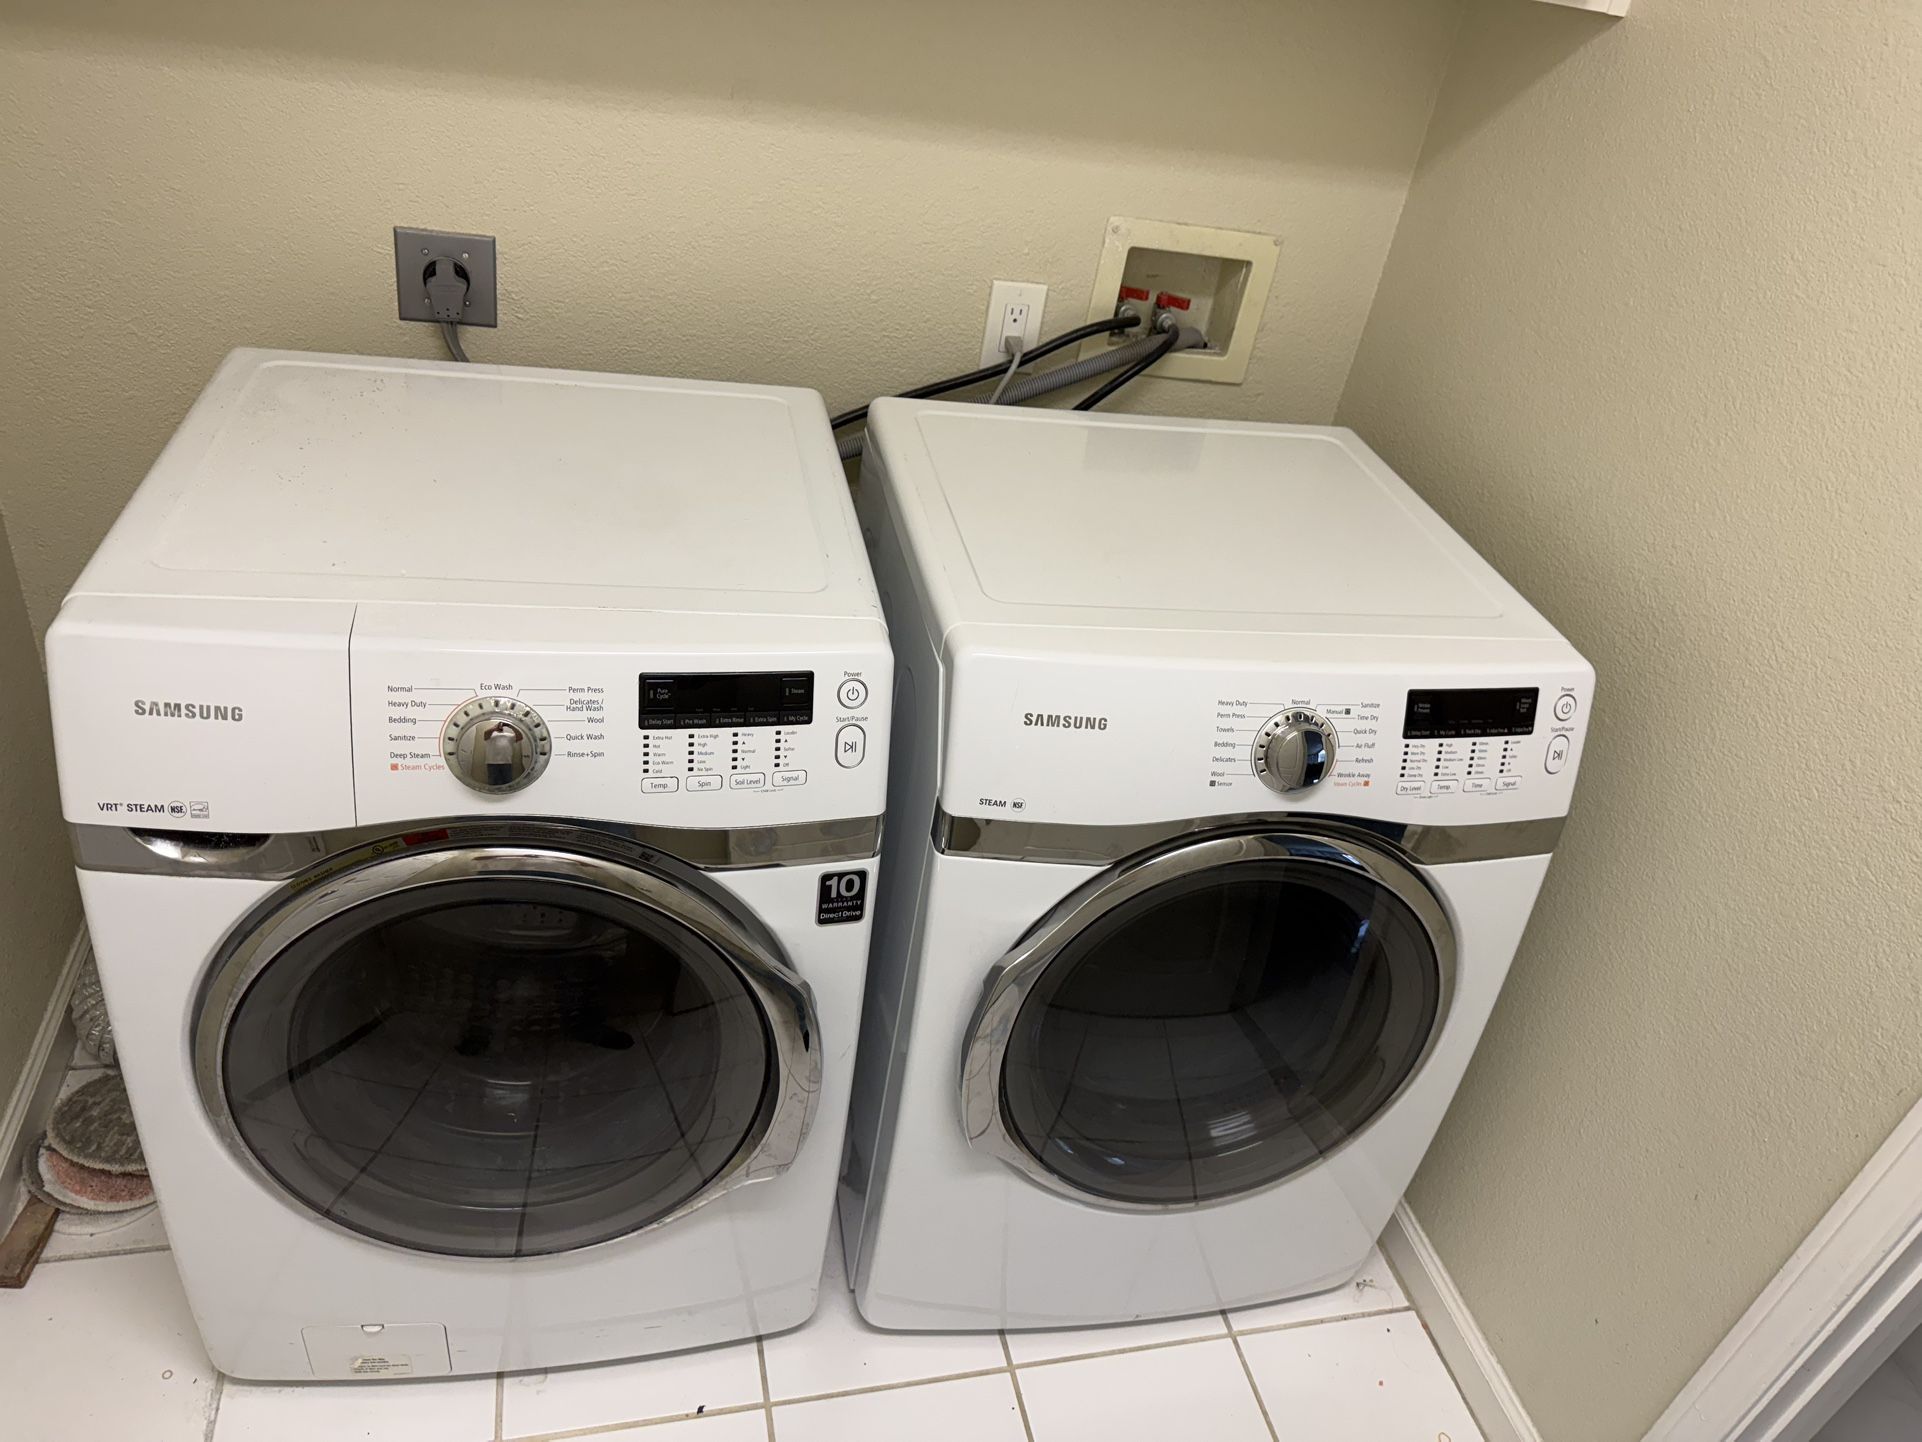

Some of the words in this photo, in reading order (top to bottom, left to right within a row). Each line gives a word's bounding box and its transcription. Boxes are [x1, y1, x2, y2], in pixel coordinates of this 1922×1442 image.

[388, 685, 412, 693] Normal
[568, 686, 585, 694] Perm
[586, 686, 604, 694] Press
[388, 700, 409, 709] Heavy
[411, 700, 427, 709] Duty
[570, 698, 598, 706] Delicates
[134, 700, 244, 722] SAMSUNG
[388, 716, 416, 725] Bedding
[587, 716, 604, 724] Wool
[836, 715, 868, 723] Start/Pause
[1024, 713, 1108, 730] SAMSUNG
[566, 734, 583, 742] Quick
[1214, 741, 1236, 749] Bedding
[390, 752, 408, 760] Deep
[567, 750, 604, 759] Rinse+Spin
[400, 763, 422, 771] Steam
[424, 763, 445, 771] Cycles
[781, 774, 800, 783] Signal
[698, 780, 712, 788] Spin
[979, 798, 1006, 807] STEAM
[127, 803, 164, 813] STEAM
[826, 874, 860, 898] 10
[822, 900, 862, 909] WARRANTY
[820, 911, 842, 919] Direct
